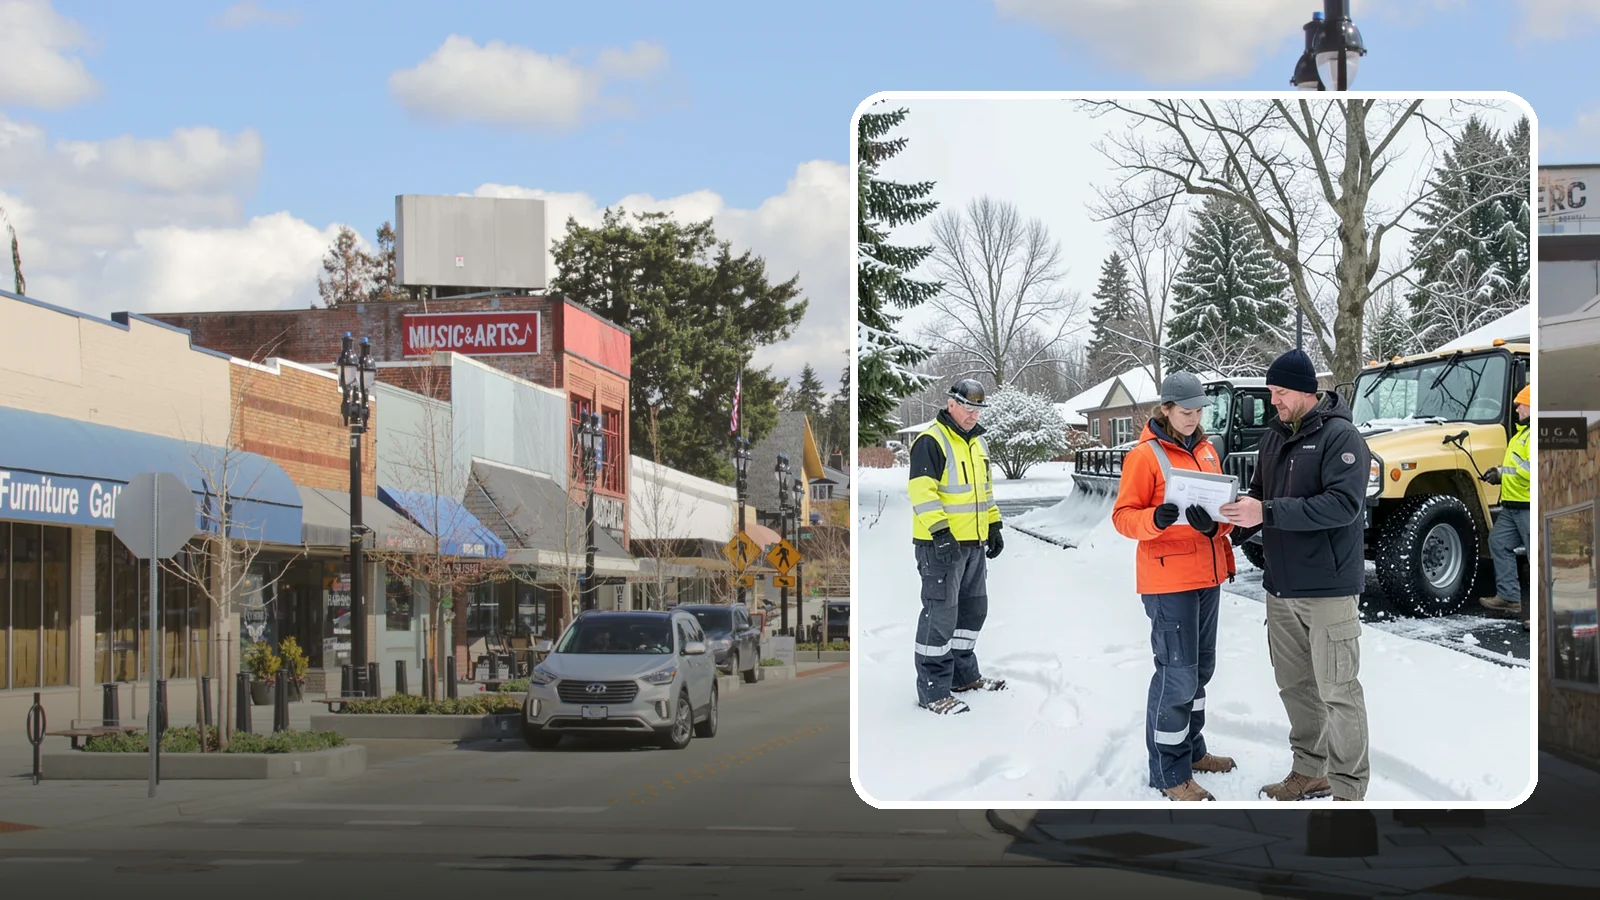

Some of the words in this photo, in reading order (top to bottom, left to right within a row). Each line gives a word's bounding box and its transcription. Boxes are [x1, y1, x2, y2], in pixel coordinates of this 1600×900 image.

[0, 471, 79, 515] Furniture
[89, 482, 122, 519] Gal
[453, 563, 480, 574] SUSHI
